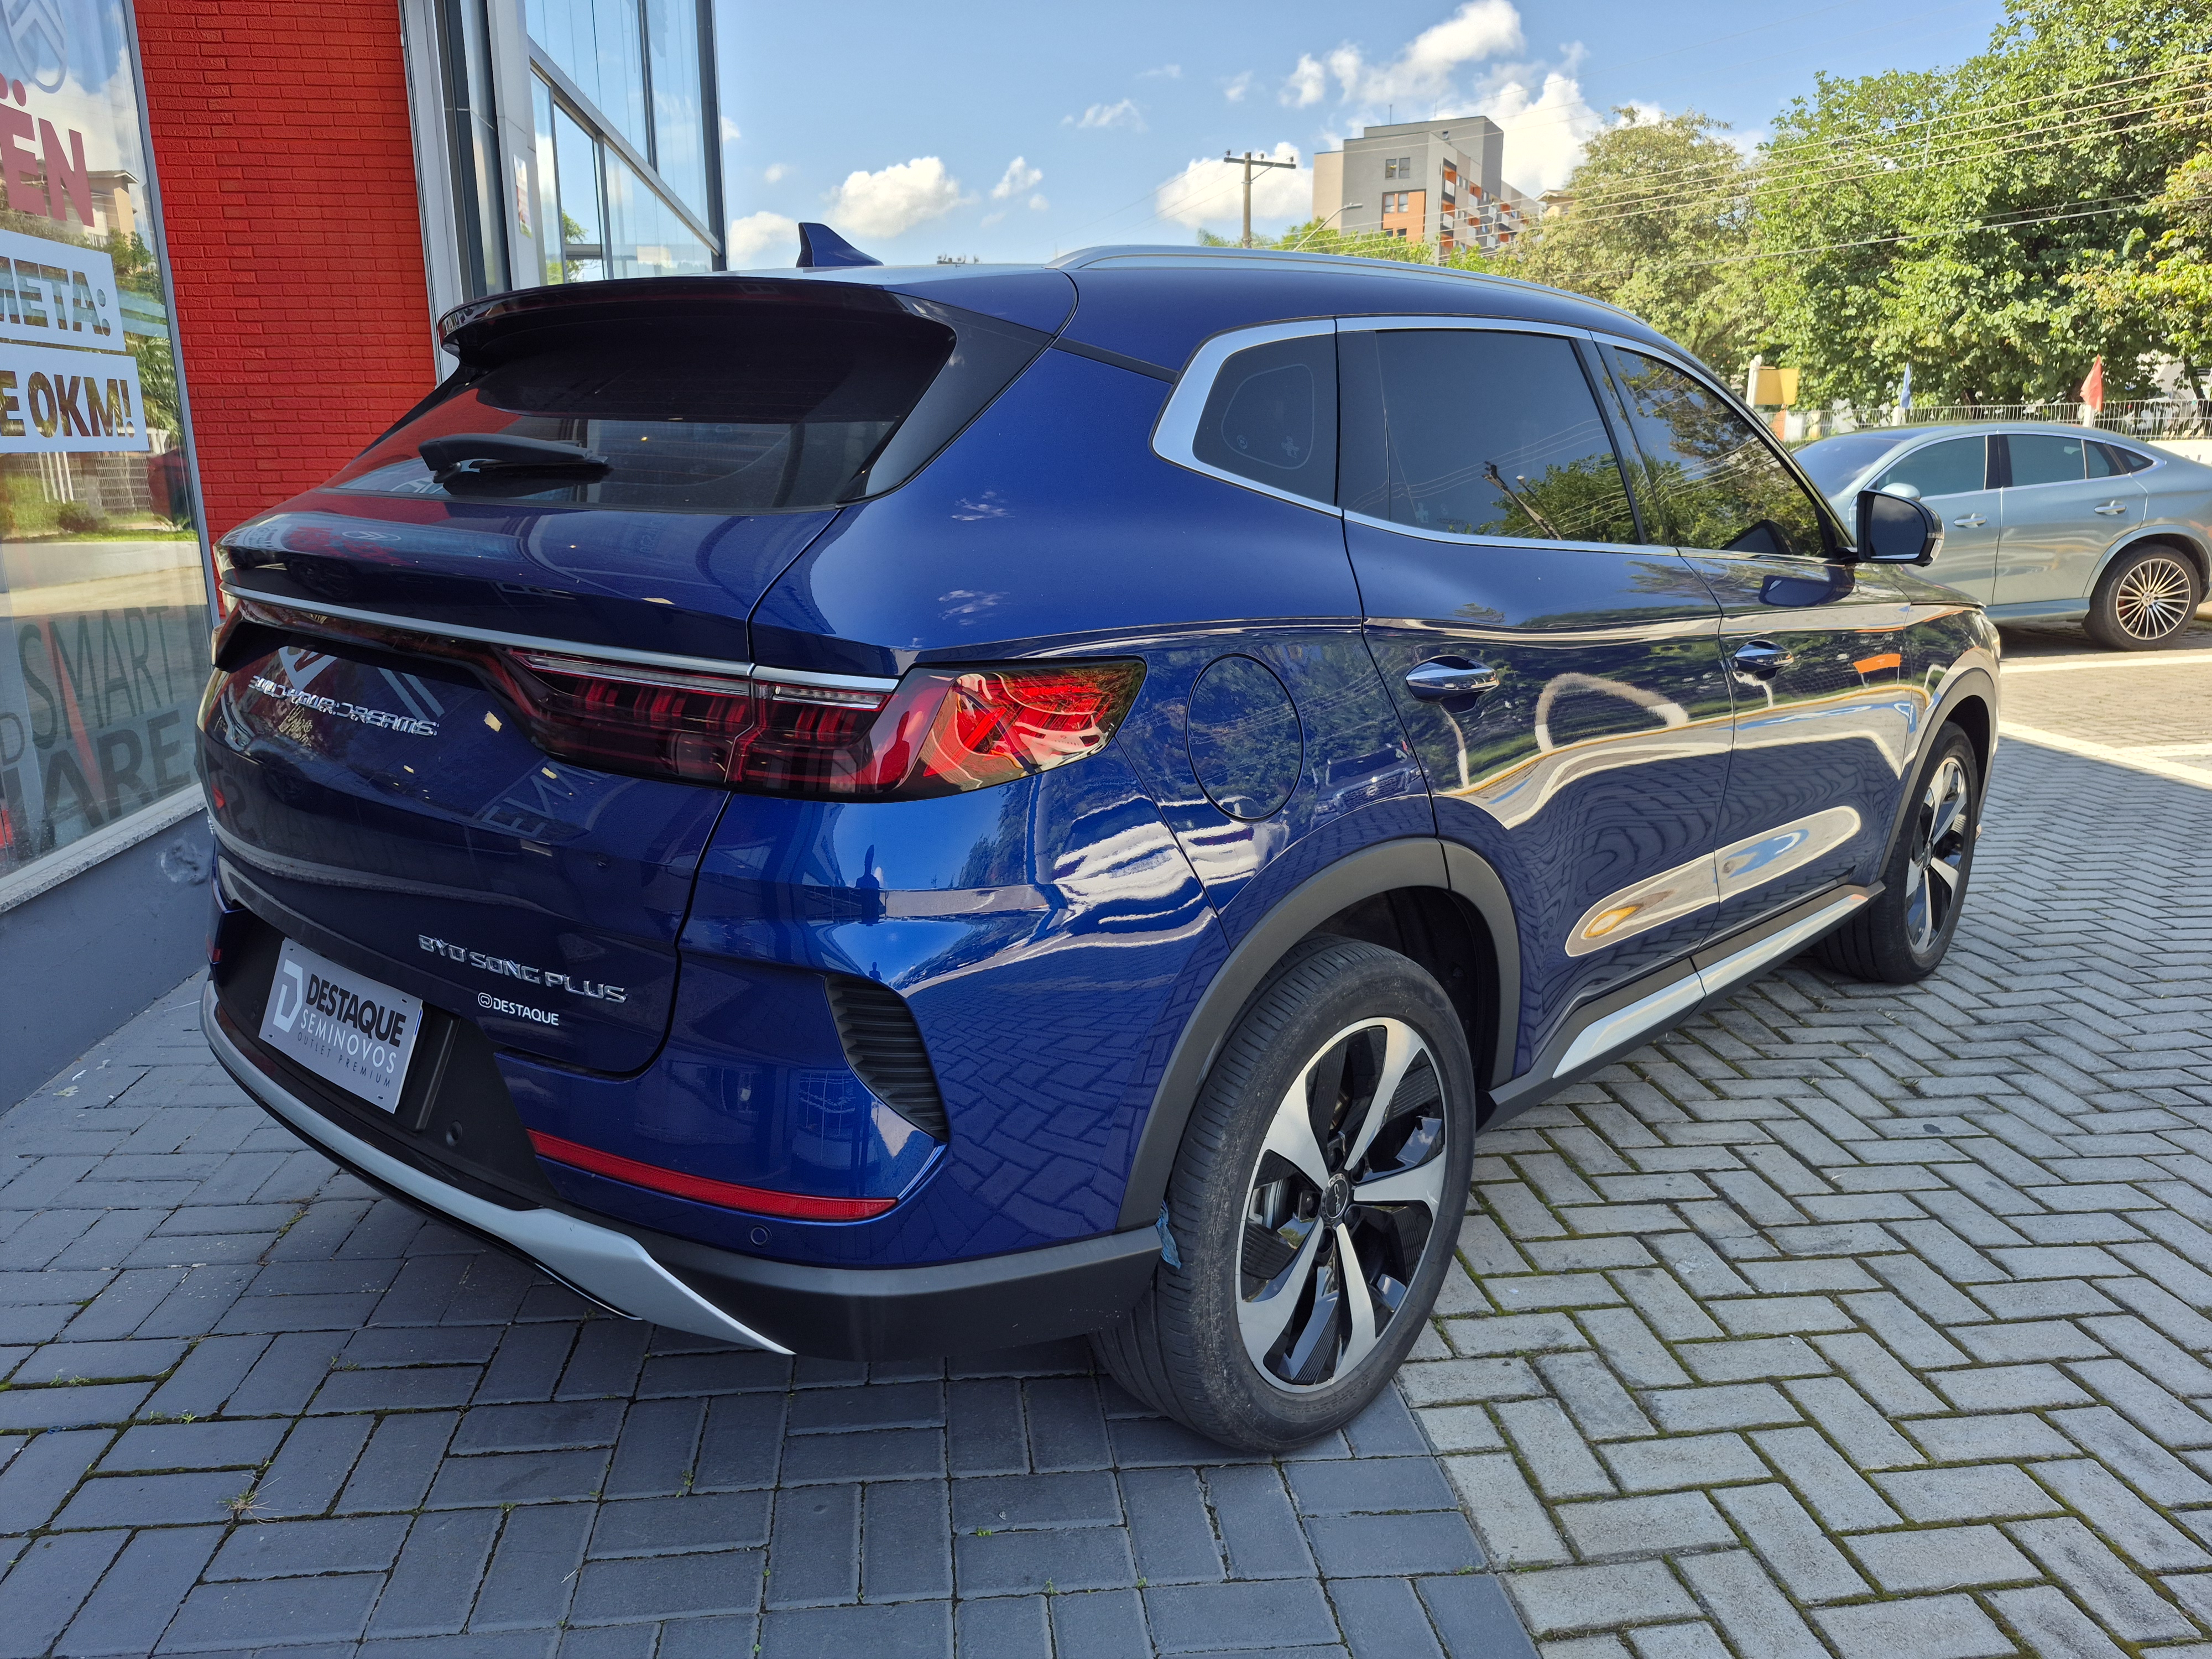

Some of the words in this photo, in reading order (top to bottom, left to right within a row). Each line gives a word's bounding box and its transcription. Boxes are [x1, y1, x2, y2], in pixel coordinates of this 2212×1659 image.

[19, 601, 174, 749] SMART
[336, 702, 440, 737] DREAMS
[468, 951, 541, 985] SONG
[544, 971, 627, 1003] PLUS
[306, 973, 407, 1047] DESTAQUE
[298, 1032, 332, 1058] OUTLET
[338, 1054, 390, 1088] PREMIUM
[300, 1009, 397, 1073] SEMINOVOS
